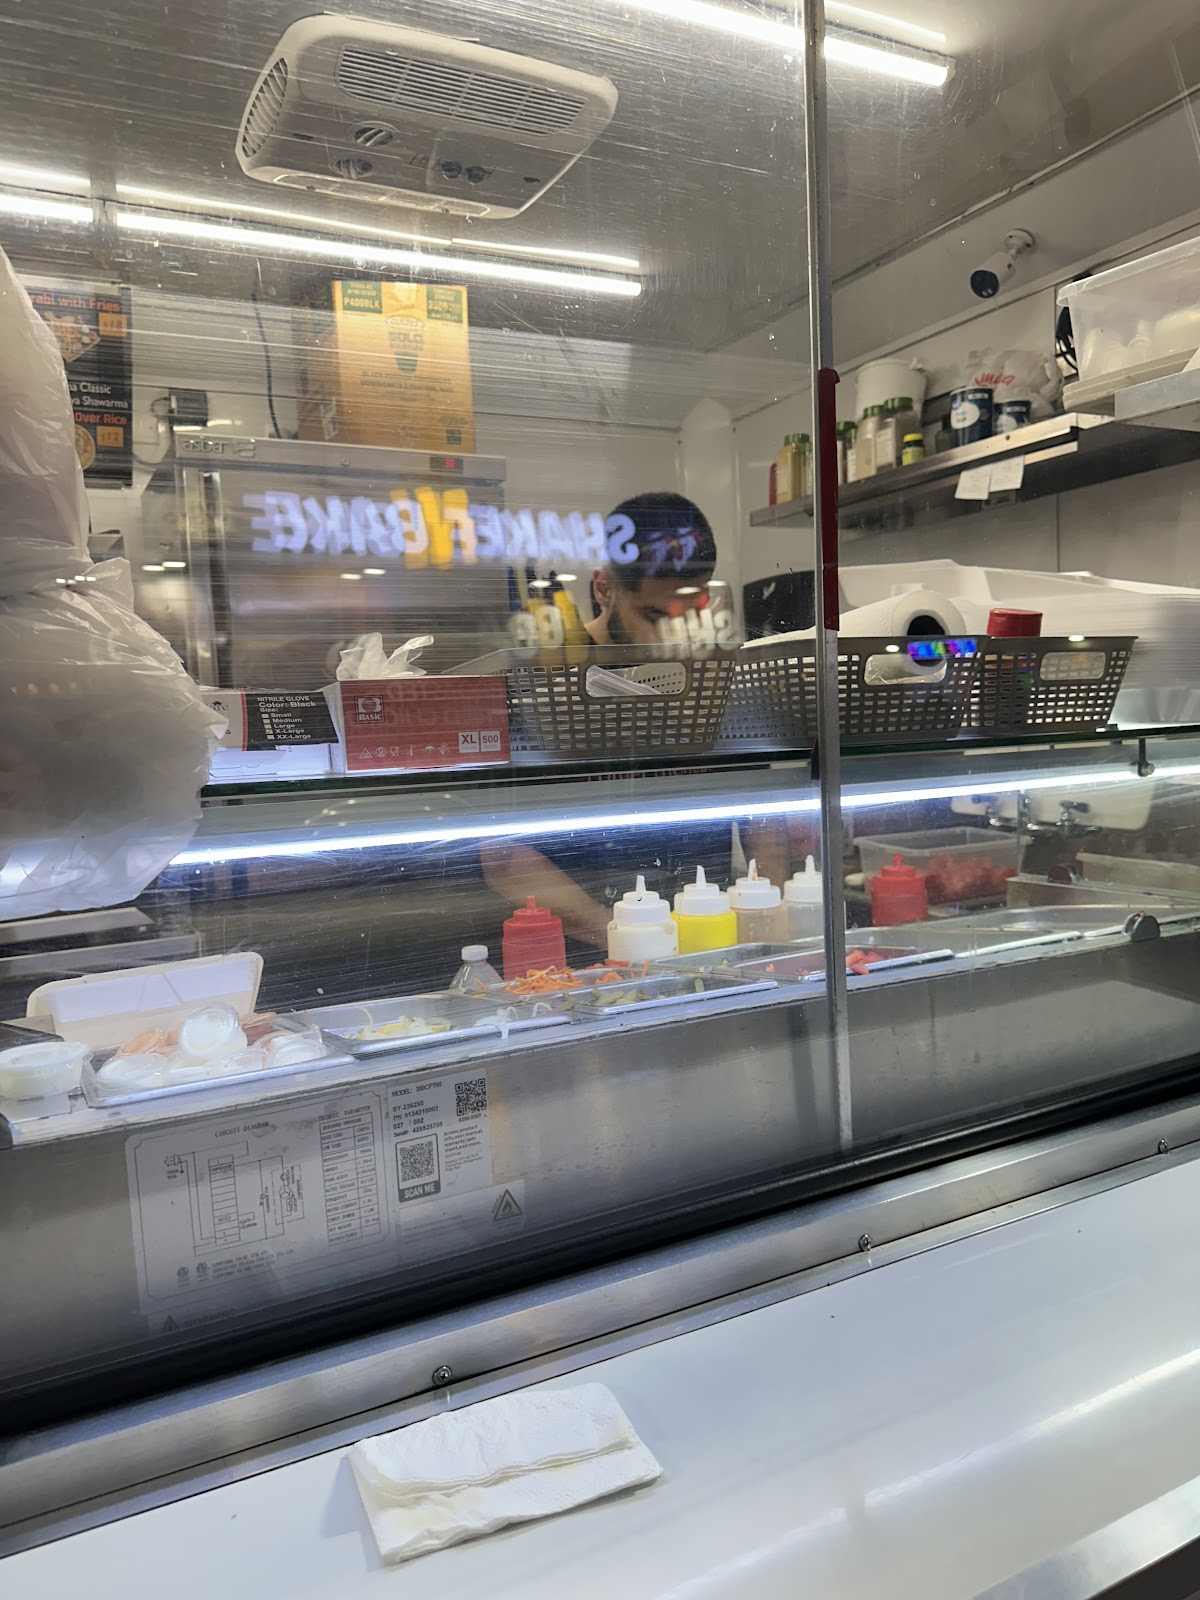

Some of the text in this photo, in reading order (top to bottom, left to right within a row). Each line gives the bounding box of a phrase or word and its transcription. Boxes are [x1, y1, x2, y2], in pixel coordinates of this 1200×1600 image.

[31, 294, 120, 312] rabi with Fries
[80, 382, 111, 394] Classic
[82, 395, 128, 409] Shawarma
[75, 411, 127, 425] Over Rice
[461, 734, 477, 744] XL
[482, 734, 499, 743] 500
[391, 1088, 413, 1097] MODEL:
[214, 1121, 269, 1137] CIRCUIT DIAGRAM
[392, 1122, 404, 1130] 027
[459, 1124, 478, 1134] product
[404, 1182, 436, 1199] SCAN ME
